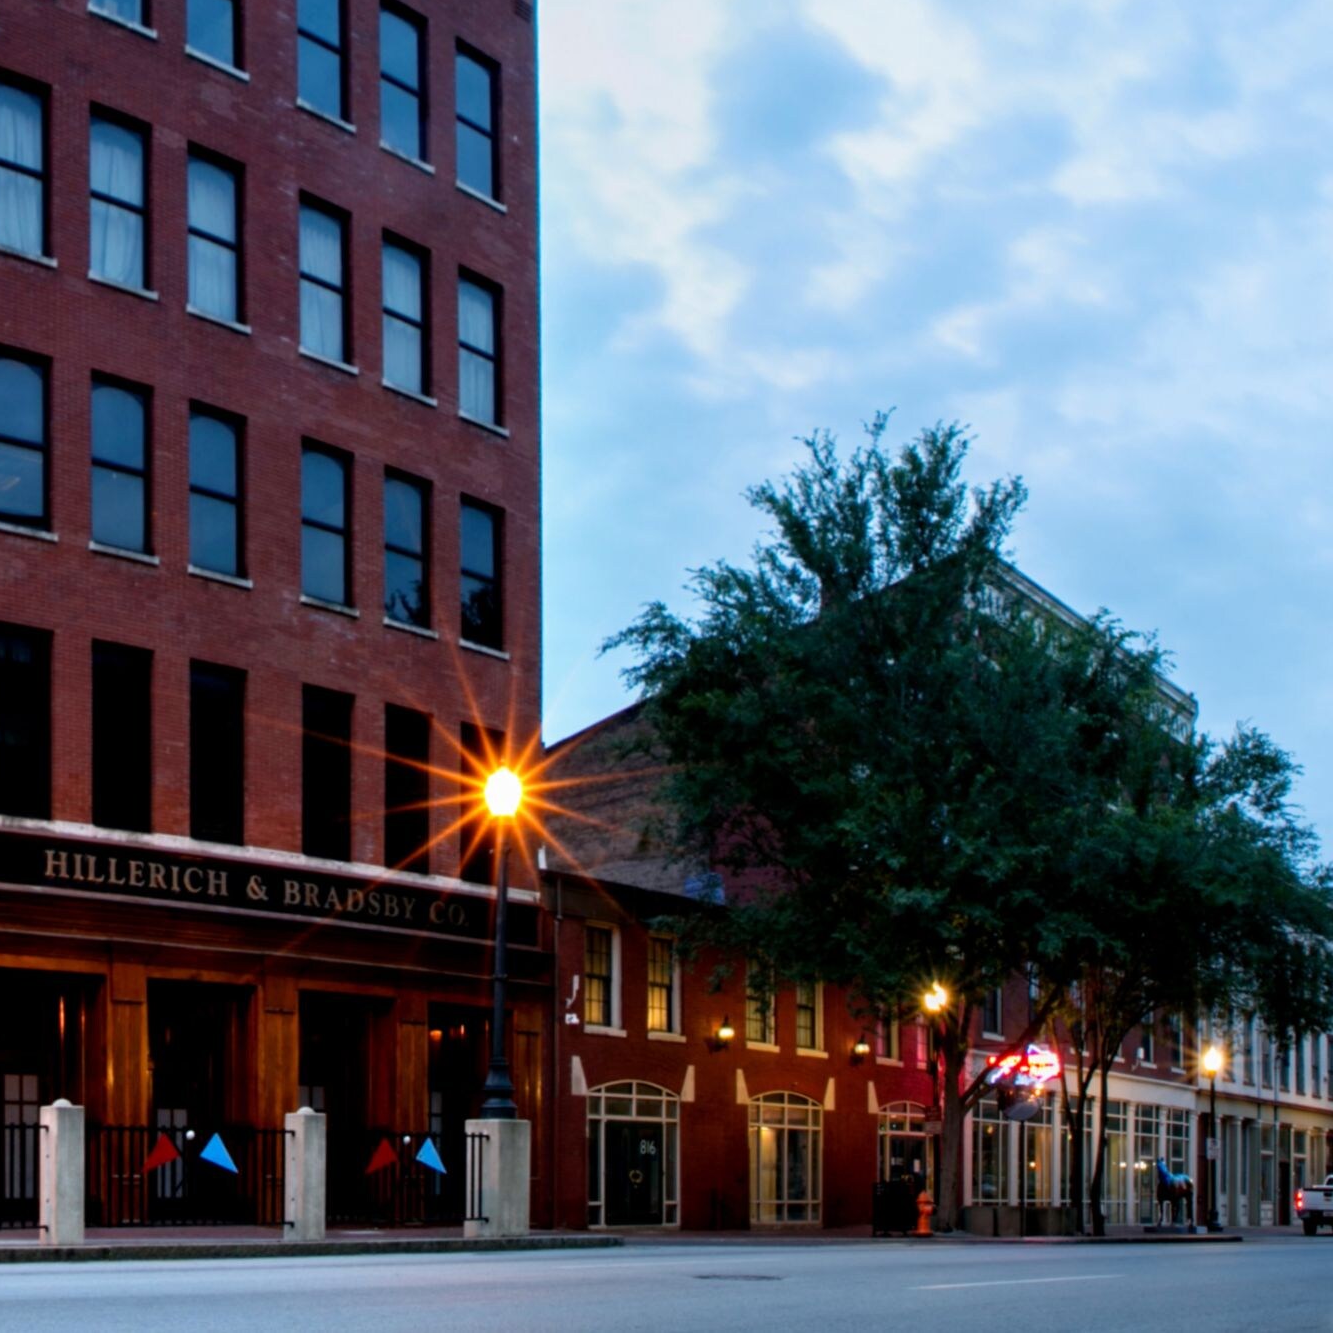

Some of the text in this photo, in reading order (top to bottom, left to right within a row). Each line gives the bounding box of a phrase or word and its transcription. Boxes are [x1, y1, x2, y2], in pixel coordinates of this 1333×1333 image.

[44, 849, 229, 897] HILLERICH
[246, 875, 269, 901] &
[283, 879, 416, 920] BRADSBY
[639, 1138, 657, 1155] 816
